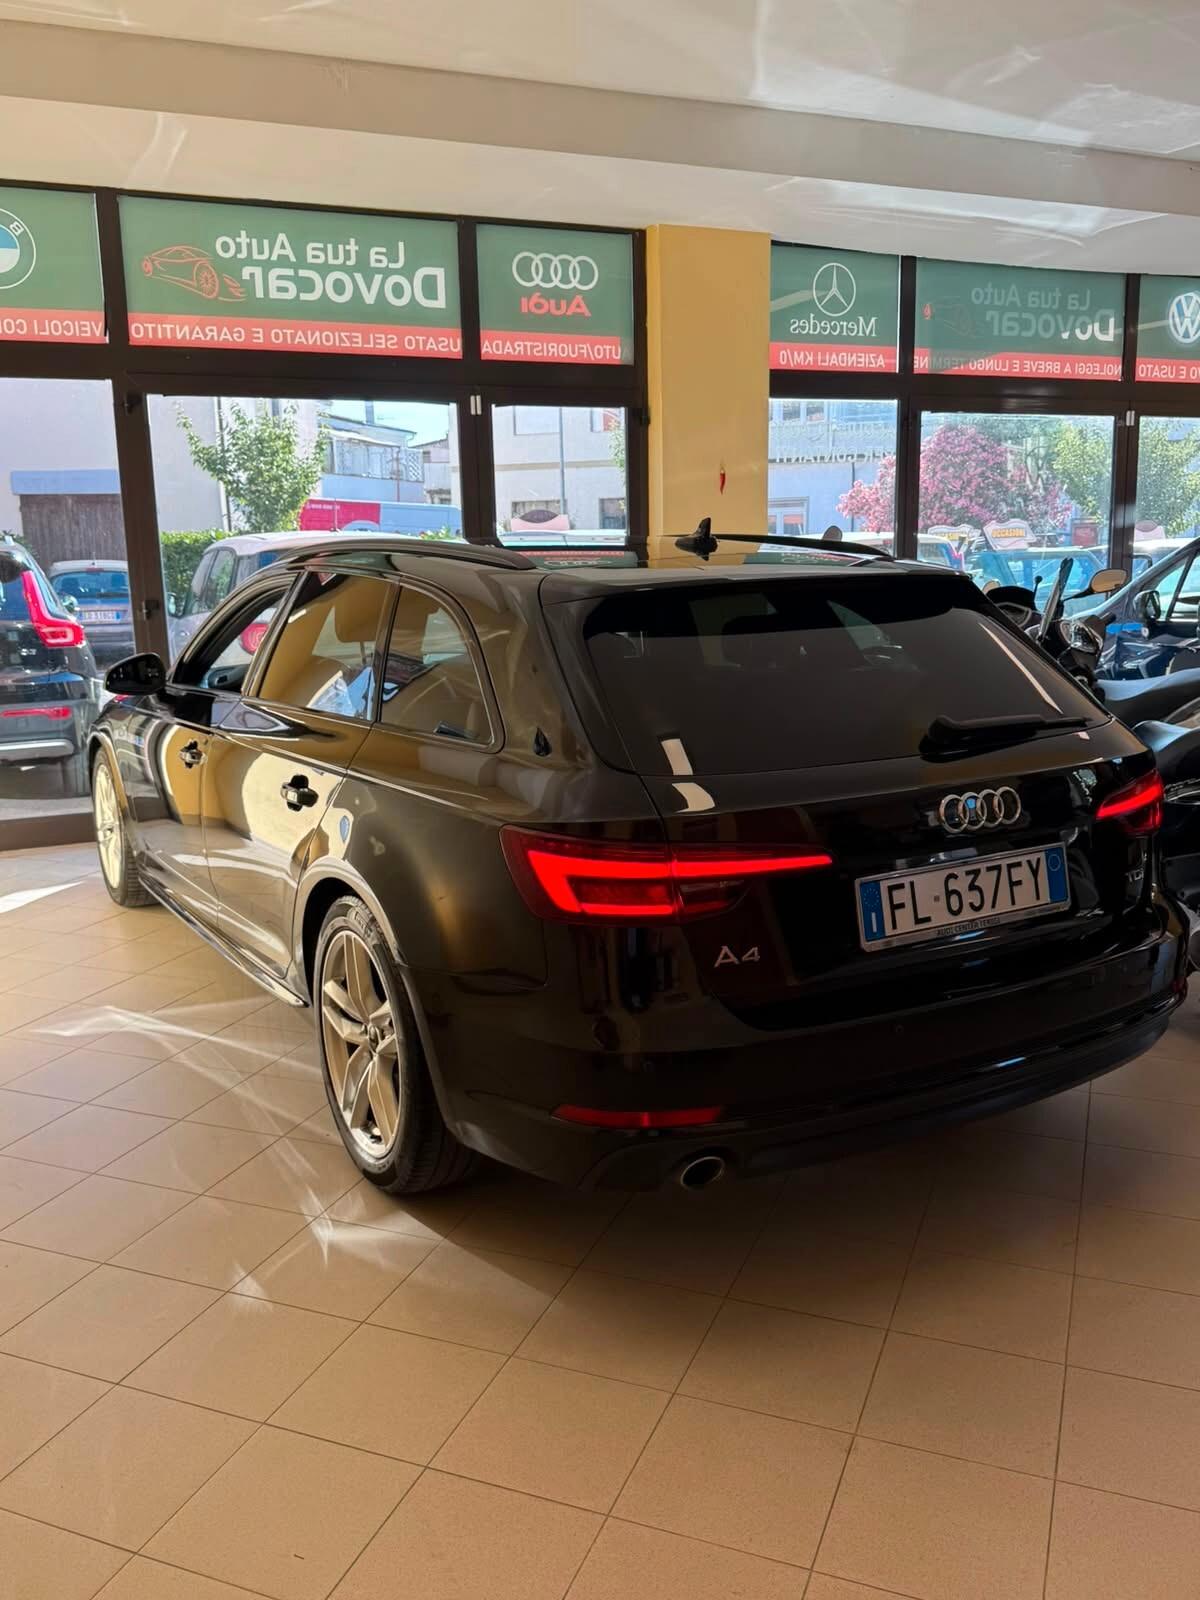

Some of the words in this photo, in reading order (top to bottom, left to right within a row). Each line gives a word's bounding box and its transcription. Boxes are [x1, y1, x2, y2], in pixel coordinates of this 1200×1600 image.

[887, 880, 932, 930] FL
[944, 857, 1042, 917] 637FY
[714, 945, 760, 968] A4
